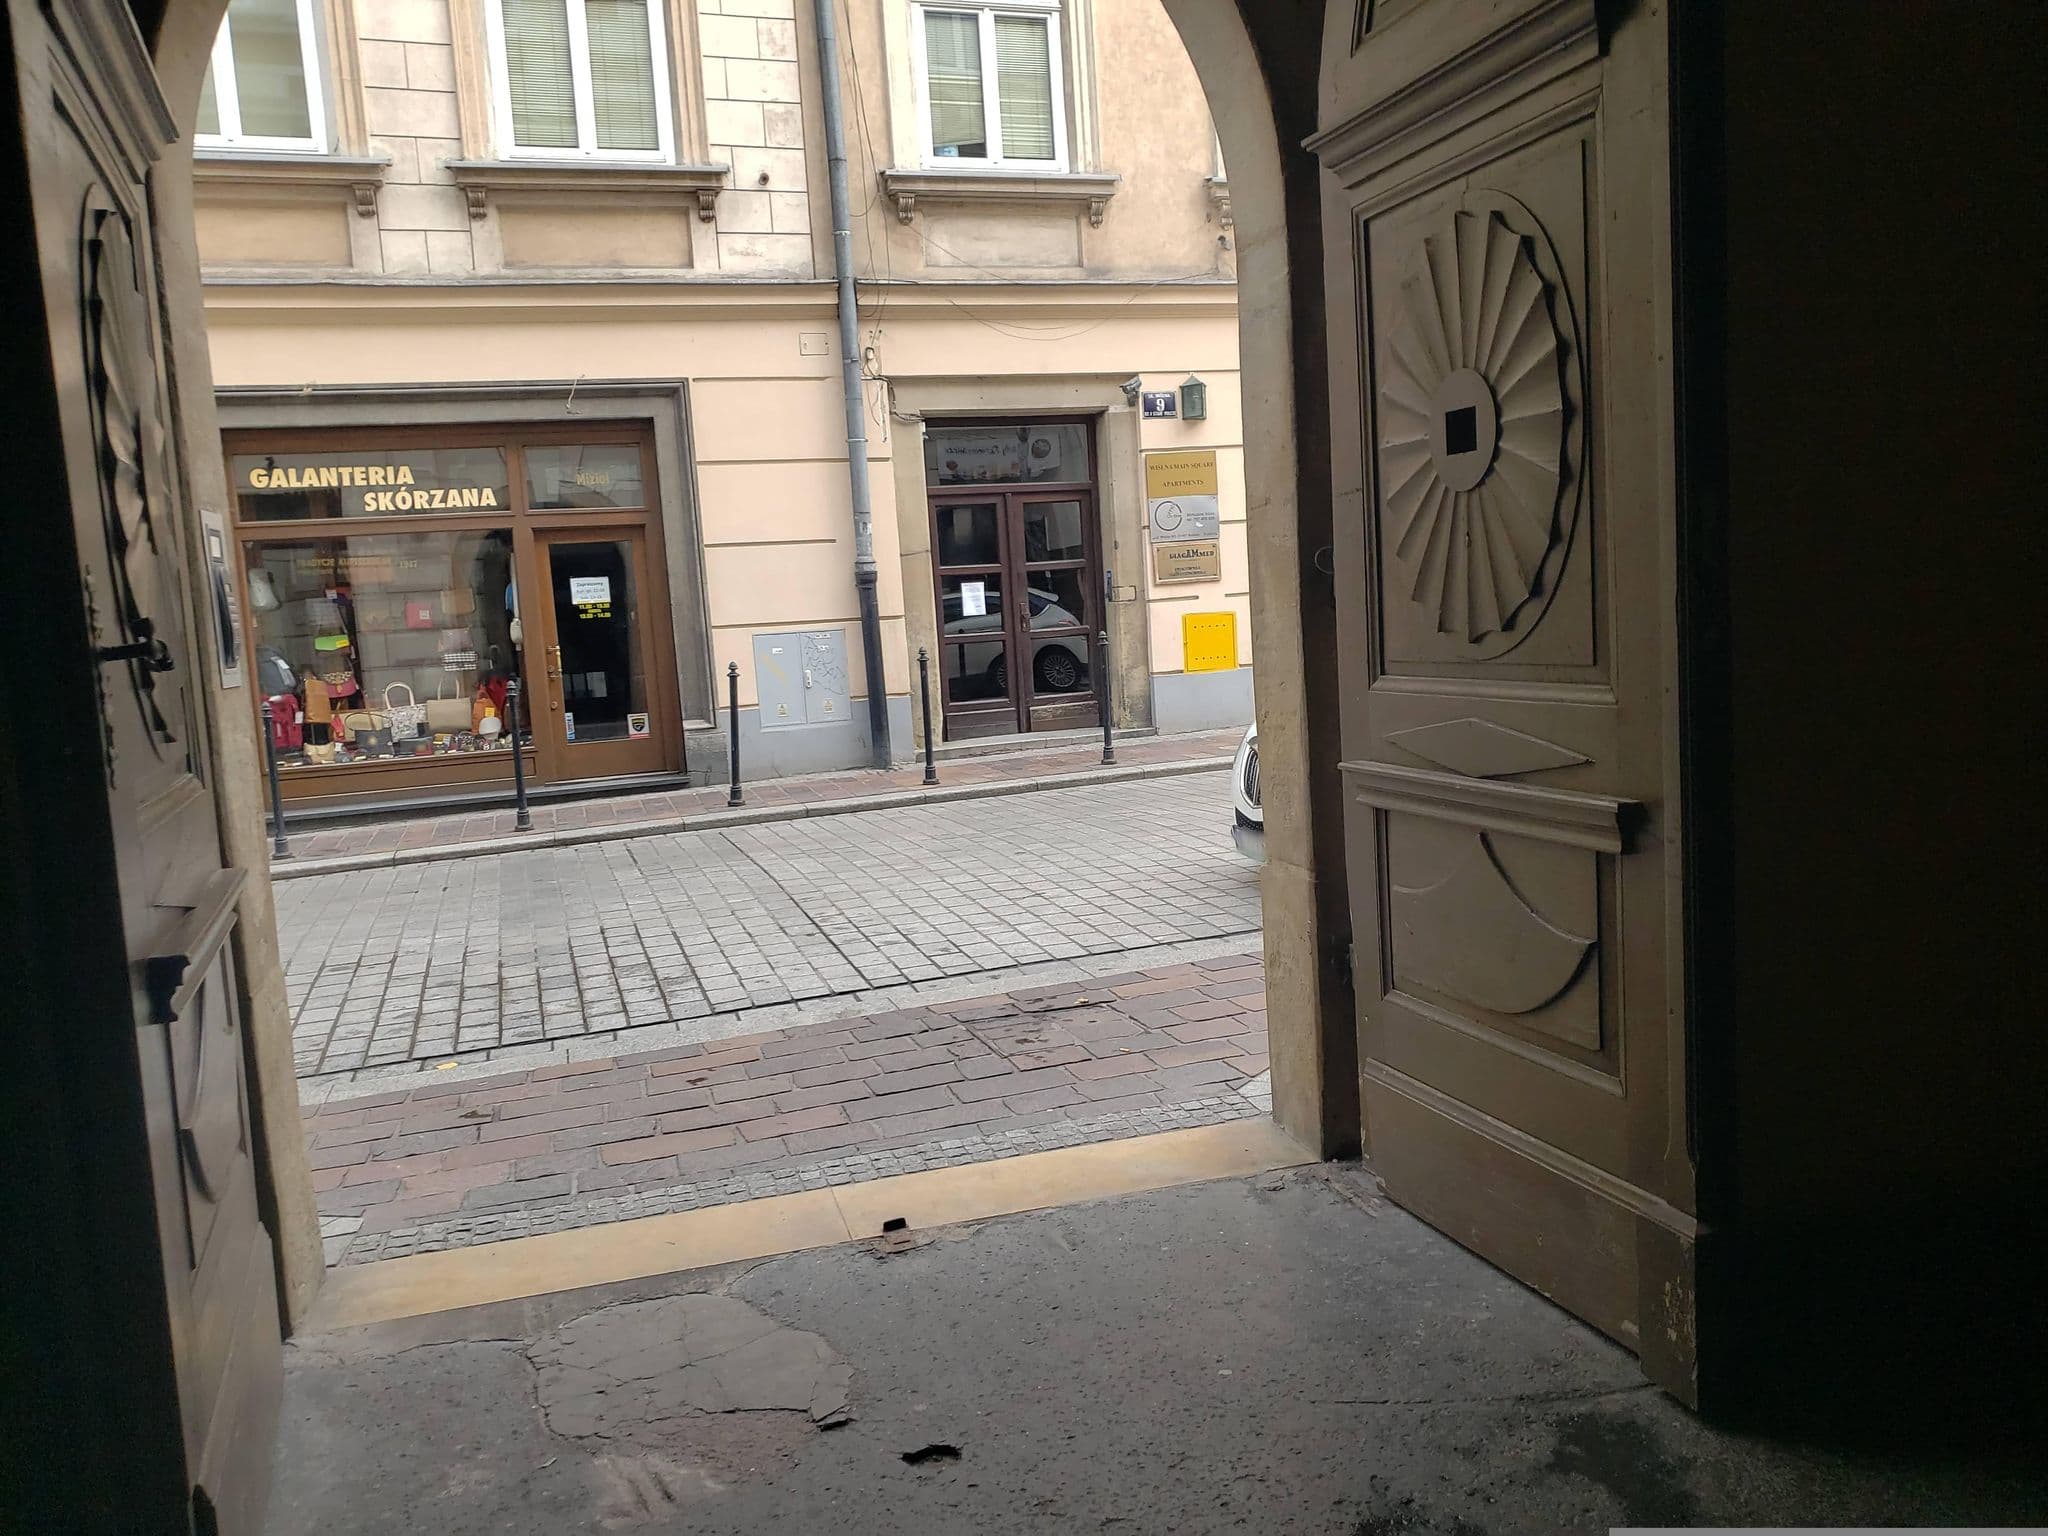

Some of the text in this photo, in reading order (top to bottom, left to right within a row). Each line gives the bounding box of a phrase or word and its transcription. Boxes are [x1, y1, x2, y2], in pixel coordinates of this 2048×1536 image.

[1156, 398, 1165, 412] 9
[249, 465, 415, 489] GALANTERIA
[363, 487, 498, 512] SKÓRZANA
